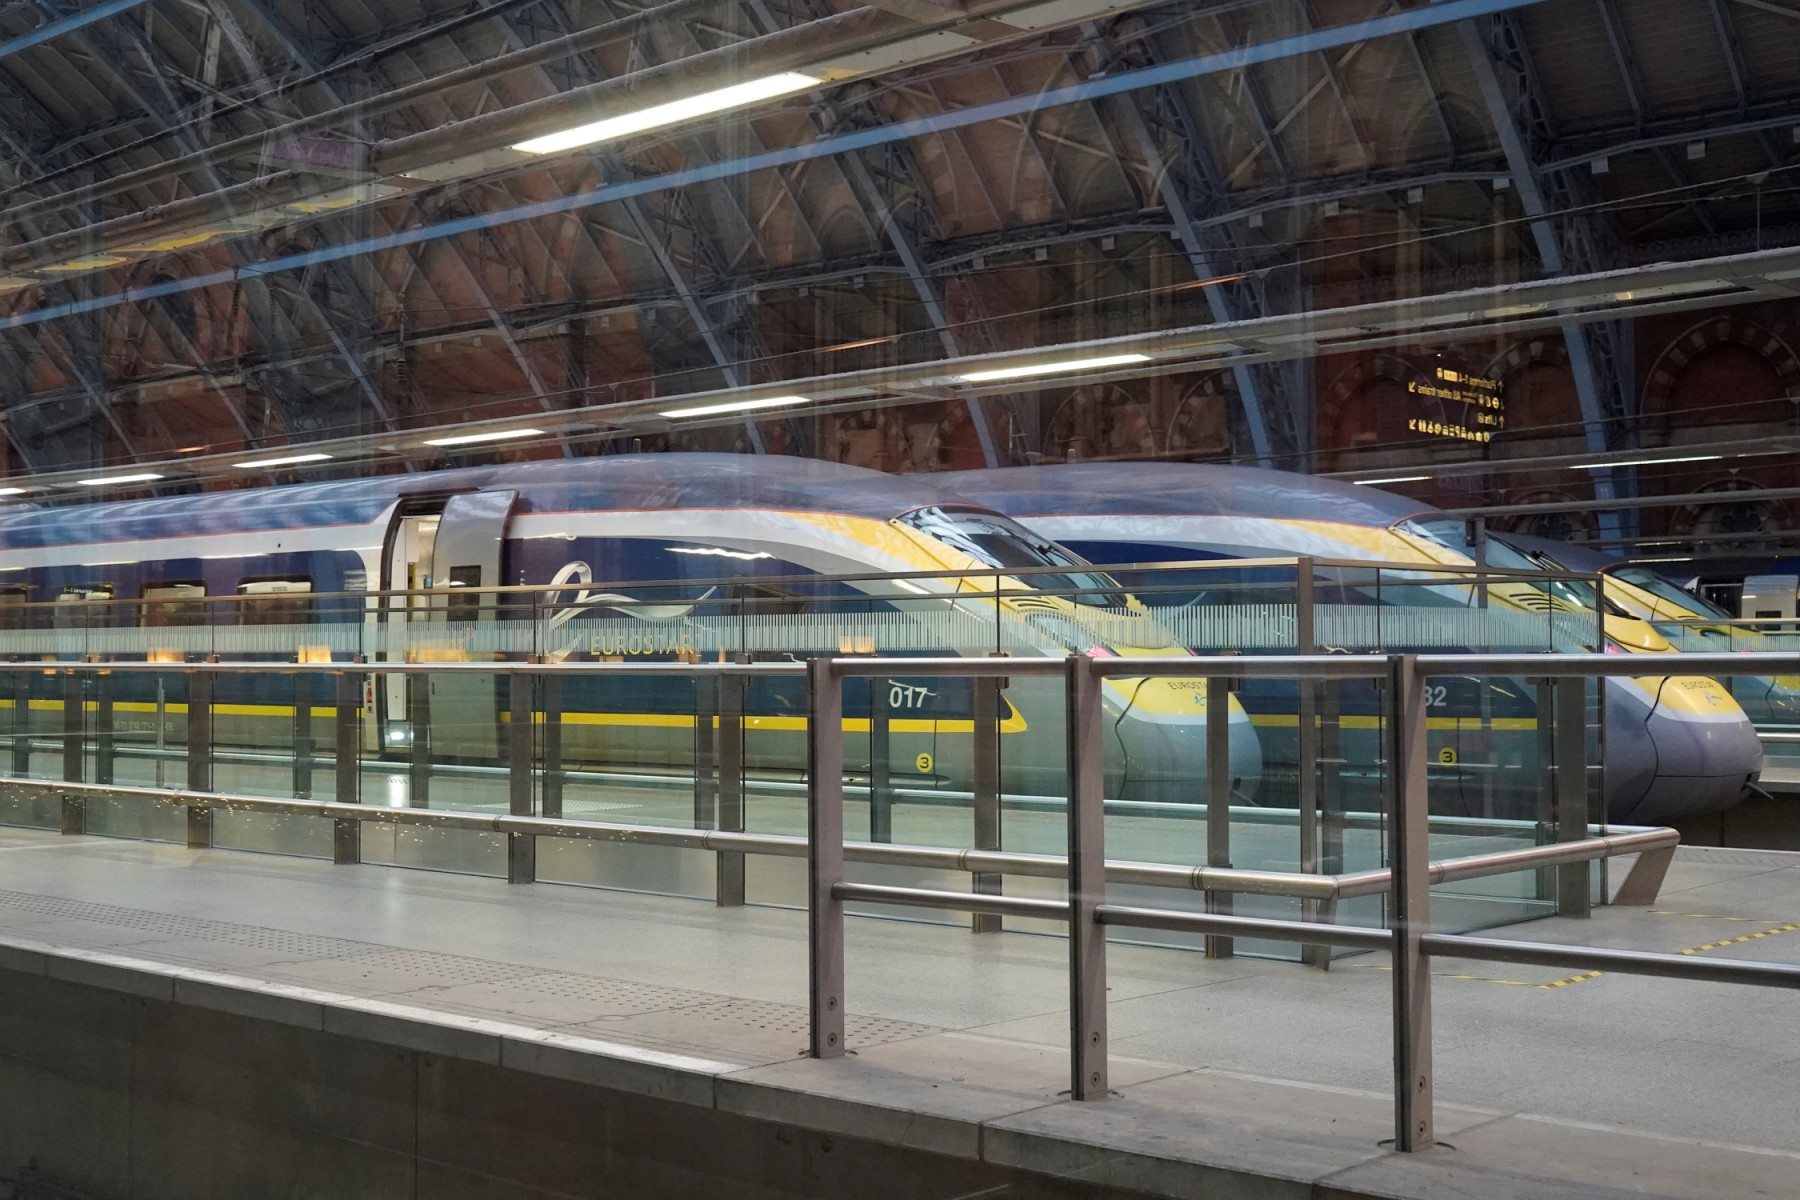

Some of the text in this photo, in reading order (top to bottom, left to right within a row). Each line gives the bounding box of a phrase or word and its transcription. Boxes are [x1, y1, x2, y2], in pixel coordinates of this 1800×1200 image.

[591, 634, 694, 656] EUROSTAR
[889, 686, 928, 708] 017
[920, 757, 929, 769] 3
[1442, 752, 1452, 763] 3
